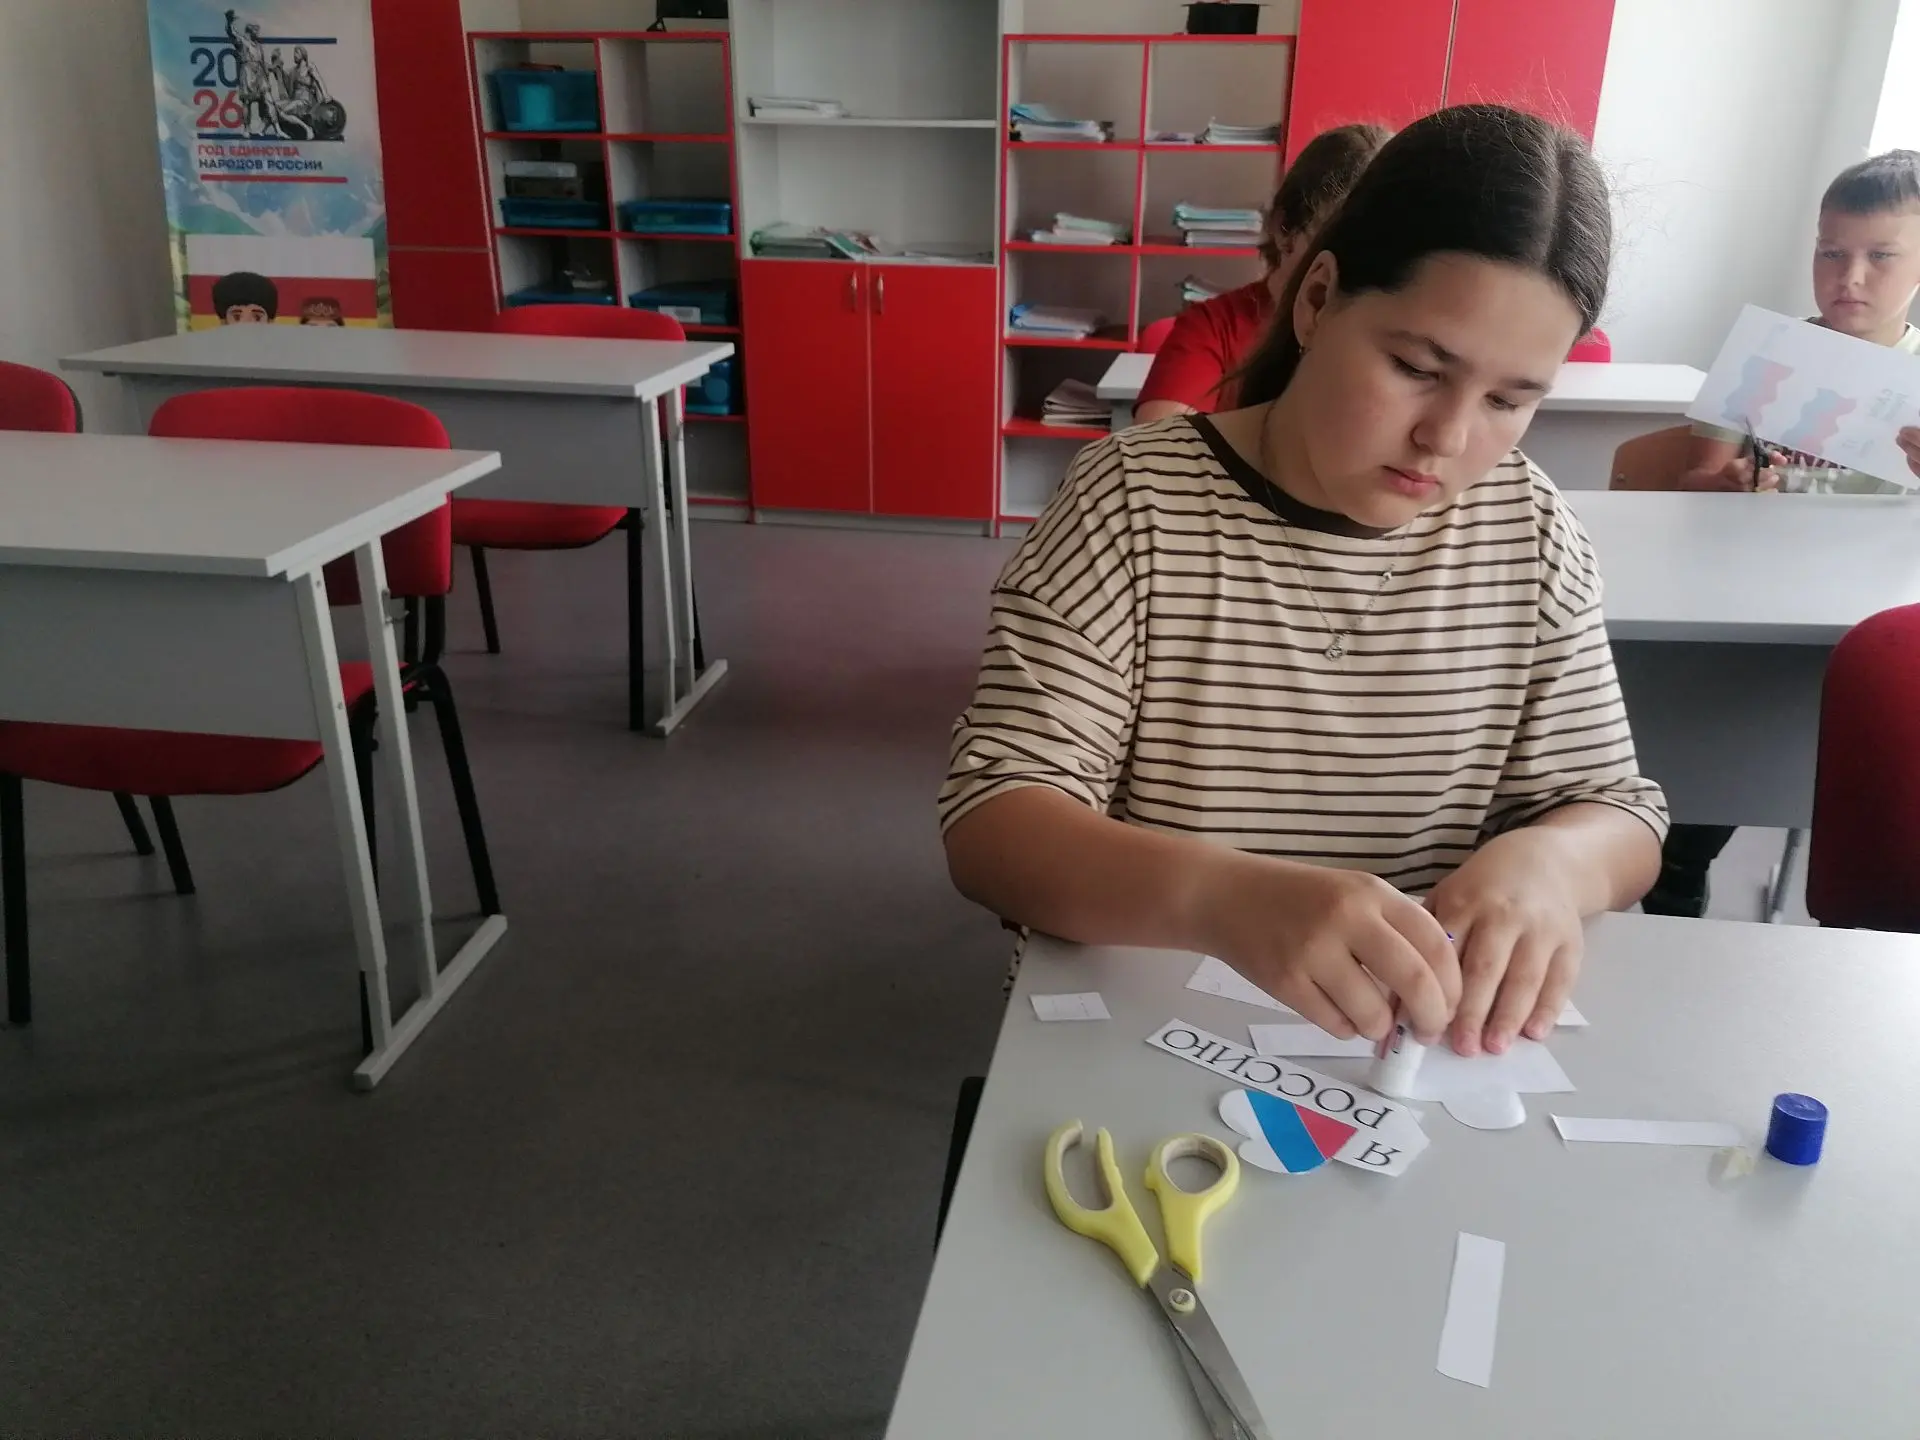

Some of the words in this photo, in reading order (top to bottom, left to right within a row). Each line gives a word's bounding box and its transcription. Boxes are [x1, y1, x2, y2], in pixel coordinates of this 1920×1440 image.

[190, 47, 240, 88] 20
[193, 88, 244, 129] 26
[198, 144, 224, 156] ГОД
[230, 145, 300, 157] ЕДИНСТВА
[199, 159, 262, 170] НАРОДОВ
[268, 160, 323, 171] РОССИИ
[1161, 1028, 1394, 1130] РОССИЮ
[1352, 1140, 1402, 1167] Я
